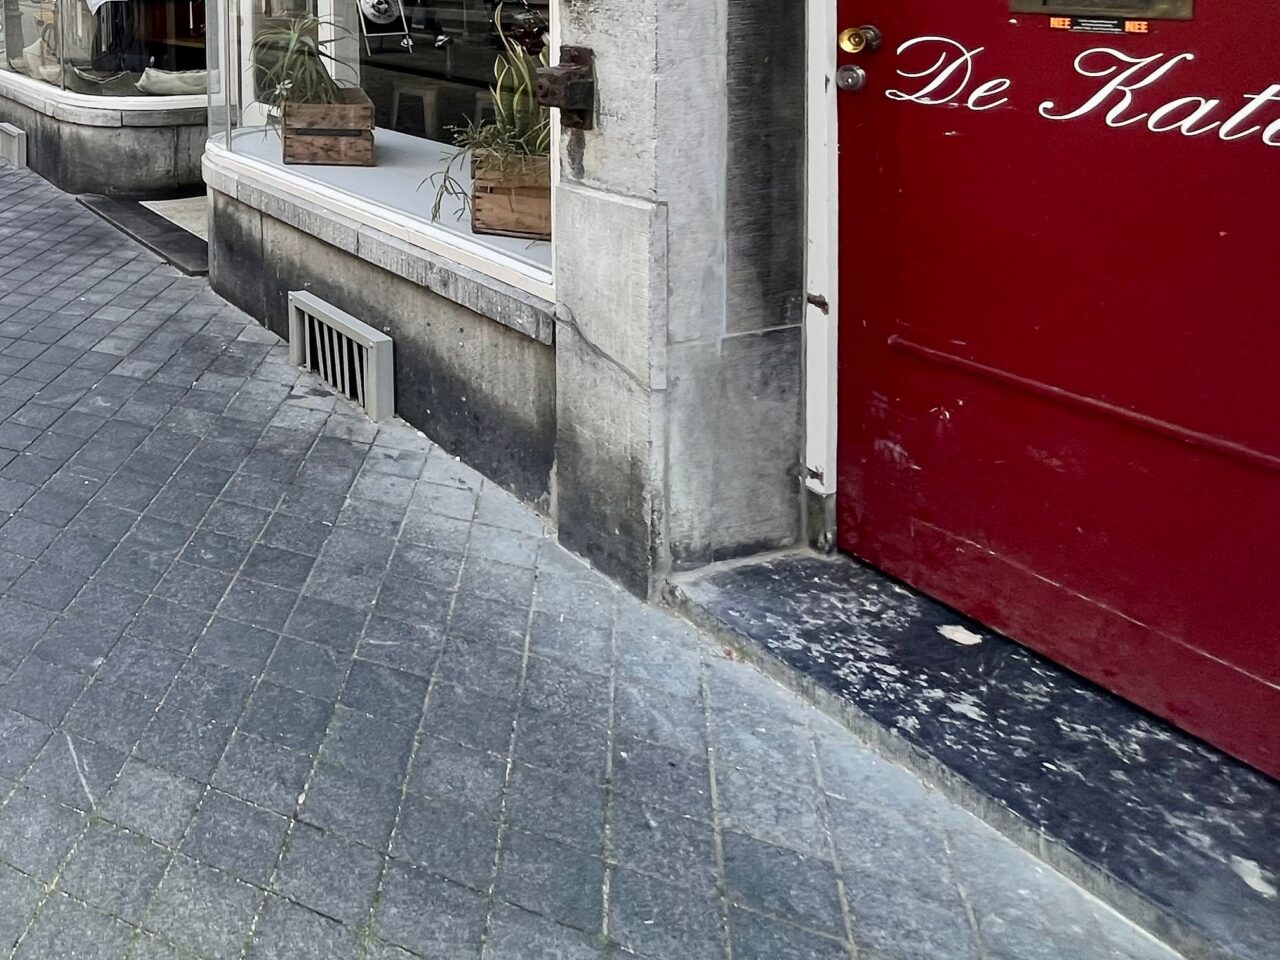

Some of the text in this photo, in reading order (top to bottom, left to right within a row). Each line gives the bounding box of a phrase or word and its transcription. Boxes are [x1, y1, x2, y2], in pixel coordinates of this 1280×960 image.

[1050, 17, 1071, 28] NEE
[1125, 20, 1148, 32] NEE
[885, 36, 1010, 110] De
